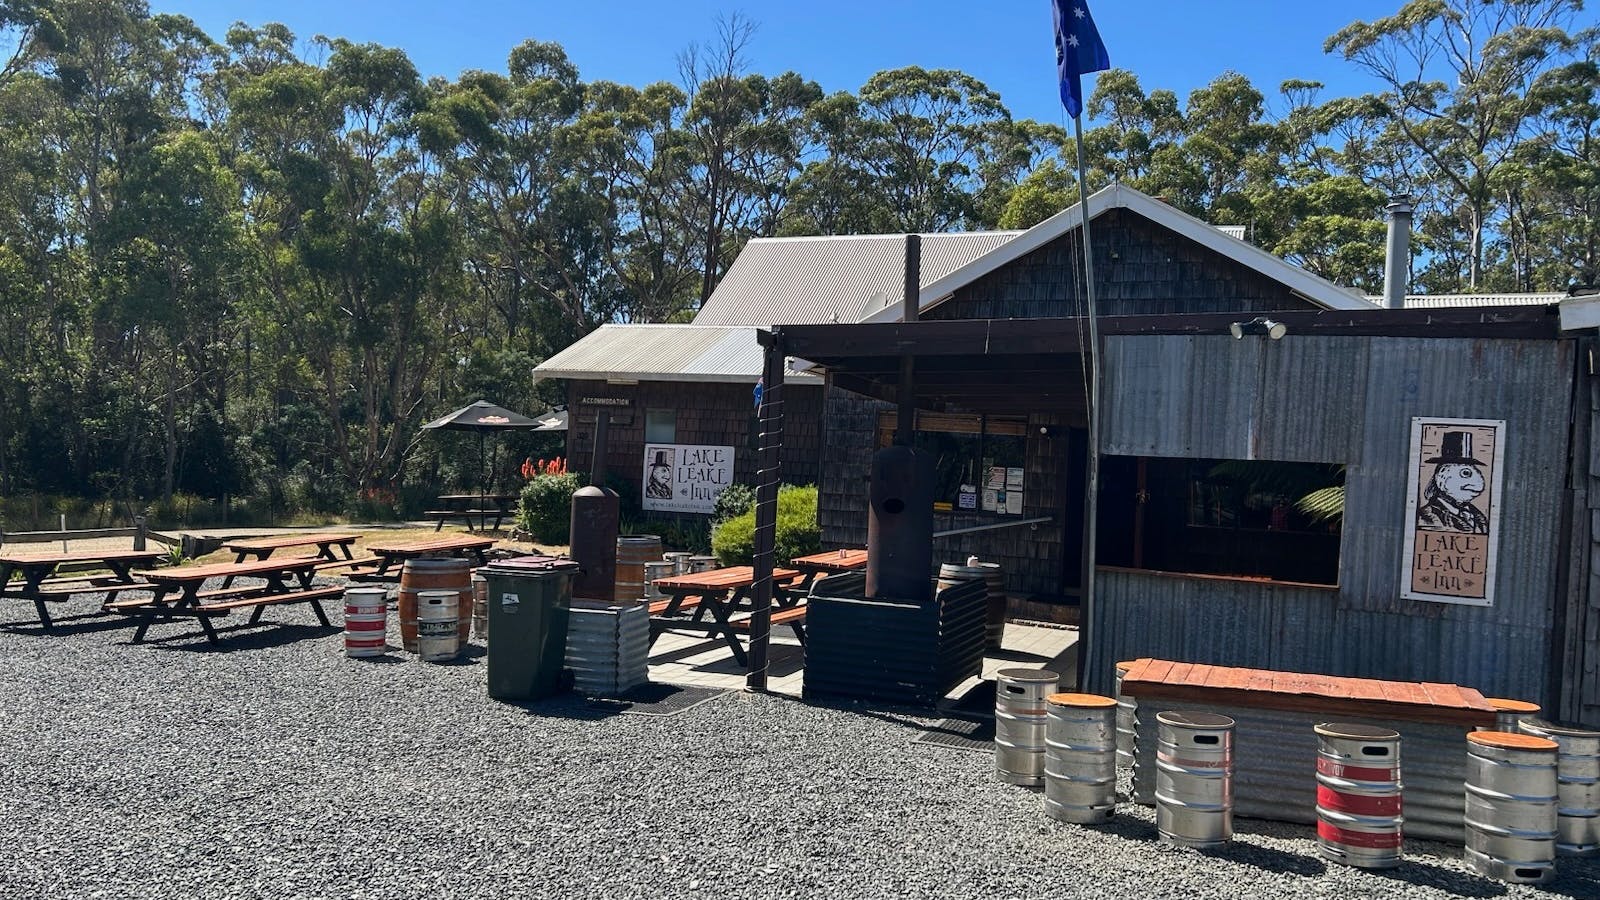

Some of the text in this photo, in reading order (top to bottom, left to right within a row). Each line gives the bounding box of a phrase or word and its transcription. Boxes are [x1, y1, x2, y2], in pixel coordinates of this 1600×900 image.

[582, 397, 630, 405] ACCOMMODATION
[682, 449, 725, 466] LAKE
[678, 467, 728, 485] LEAKE
[690, 483, 711, 500] Inn
[1423, 534, 1479, 554] LAKE
[1417, 553, 1483, 574] LEAKE
[1434, 571, 1461, 590] Inn
